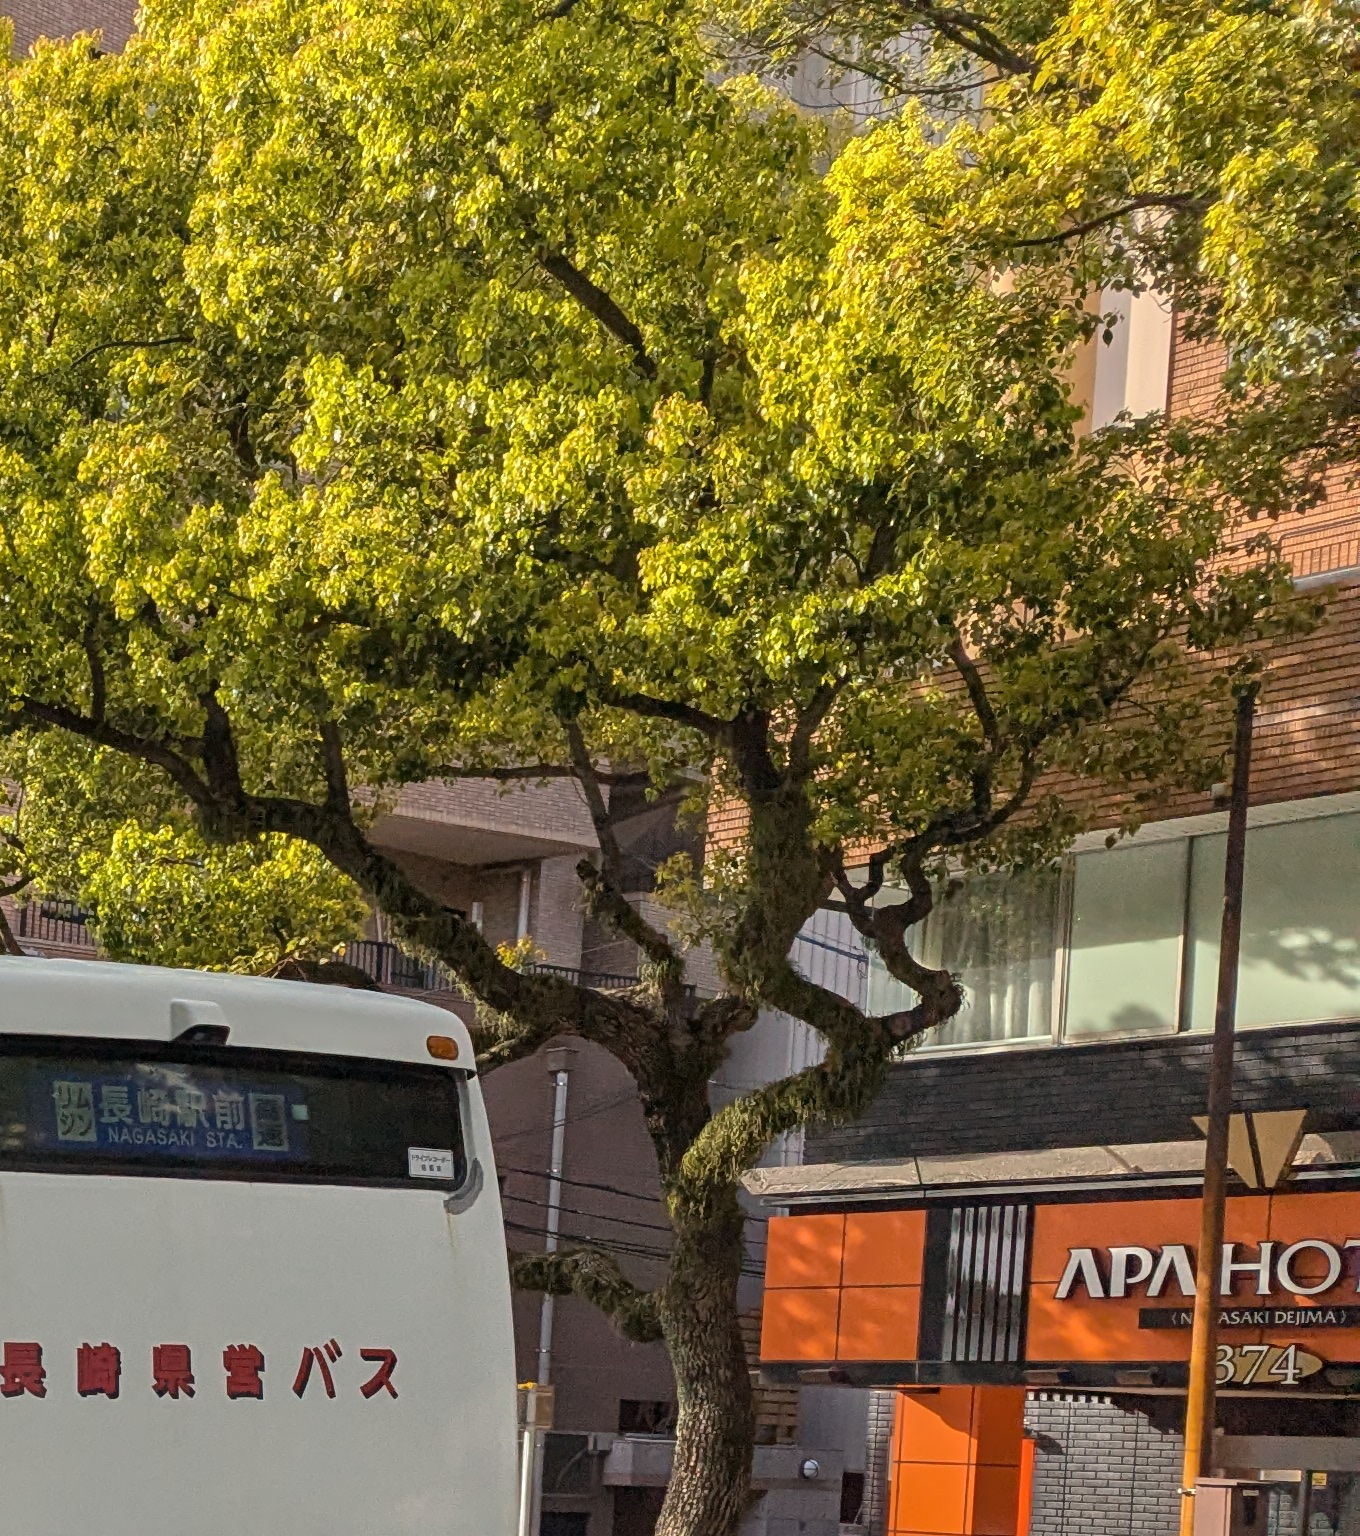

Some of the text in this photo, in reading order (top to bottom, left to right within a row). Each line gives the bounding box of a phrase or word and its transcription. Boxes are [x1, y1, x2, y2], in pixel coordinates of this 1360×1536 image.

[108, 1126, 243, 1149] NAGASAKI STA.
[1055, 1245, 1197, 1299] APA
[0, 1338, 399, 1400] 長崎県営バス
[1216, 1344, 1302, 1385] 374
